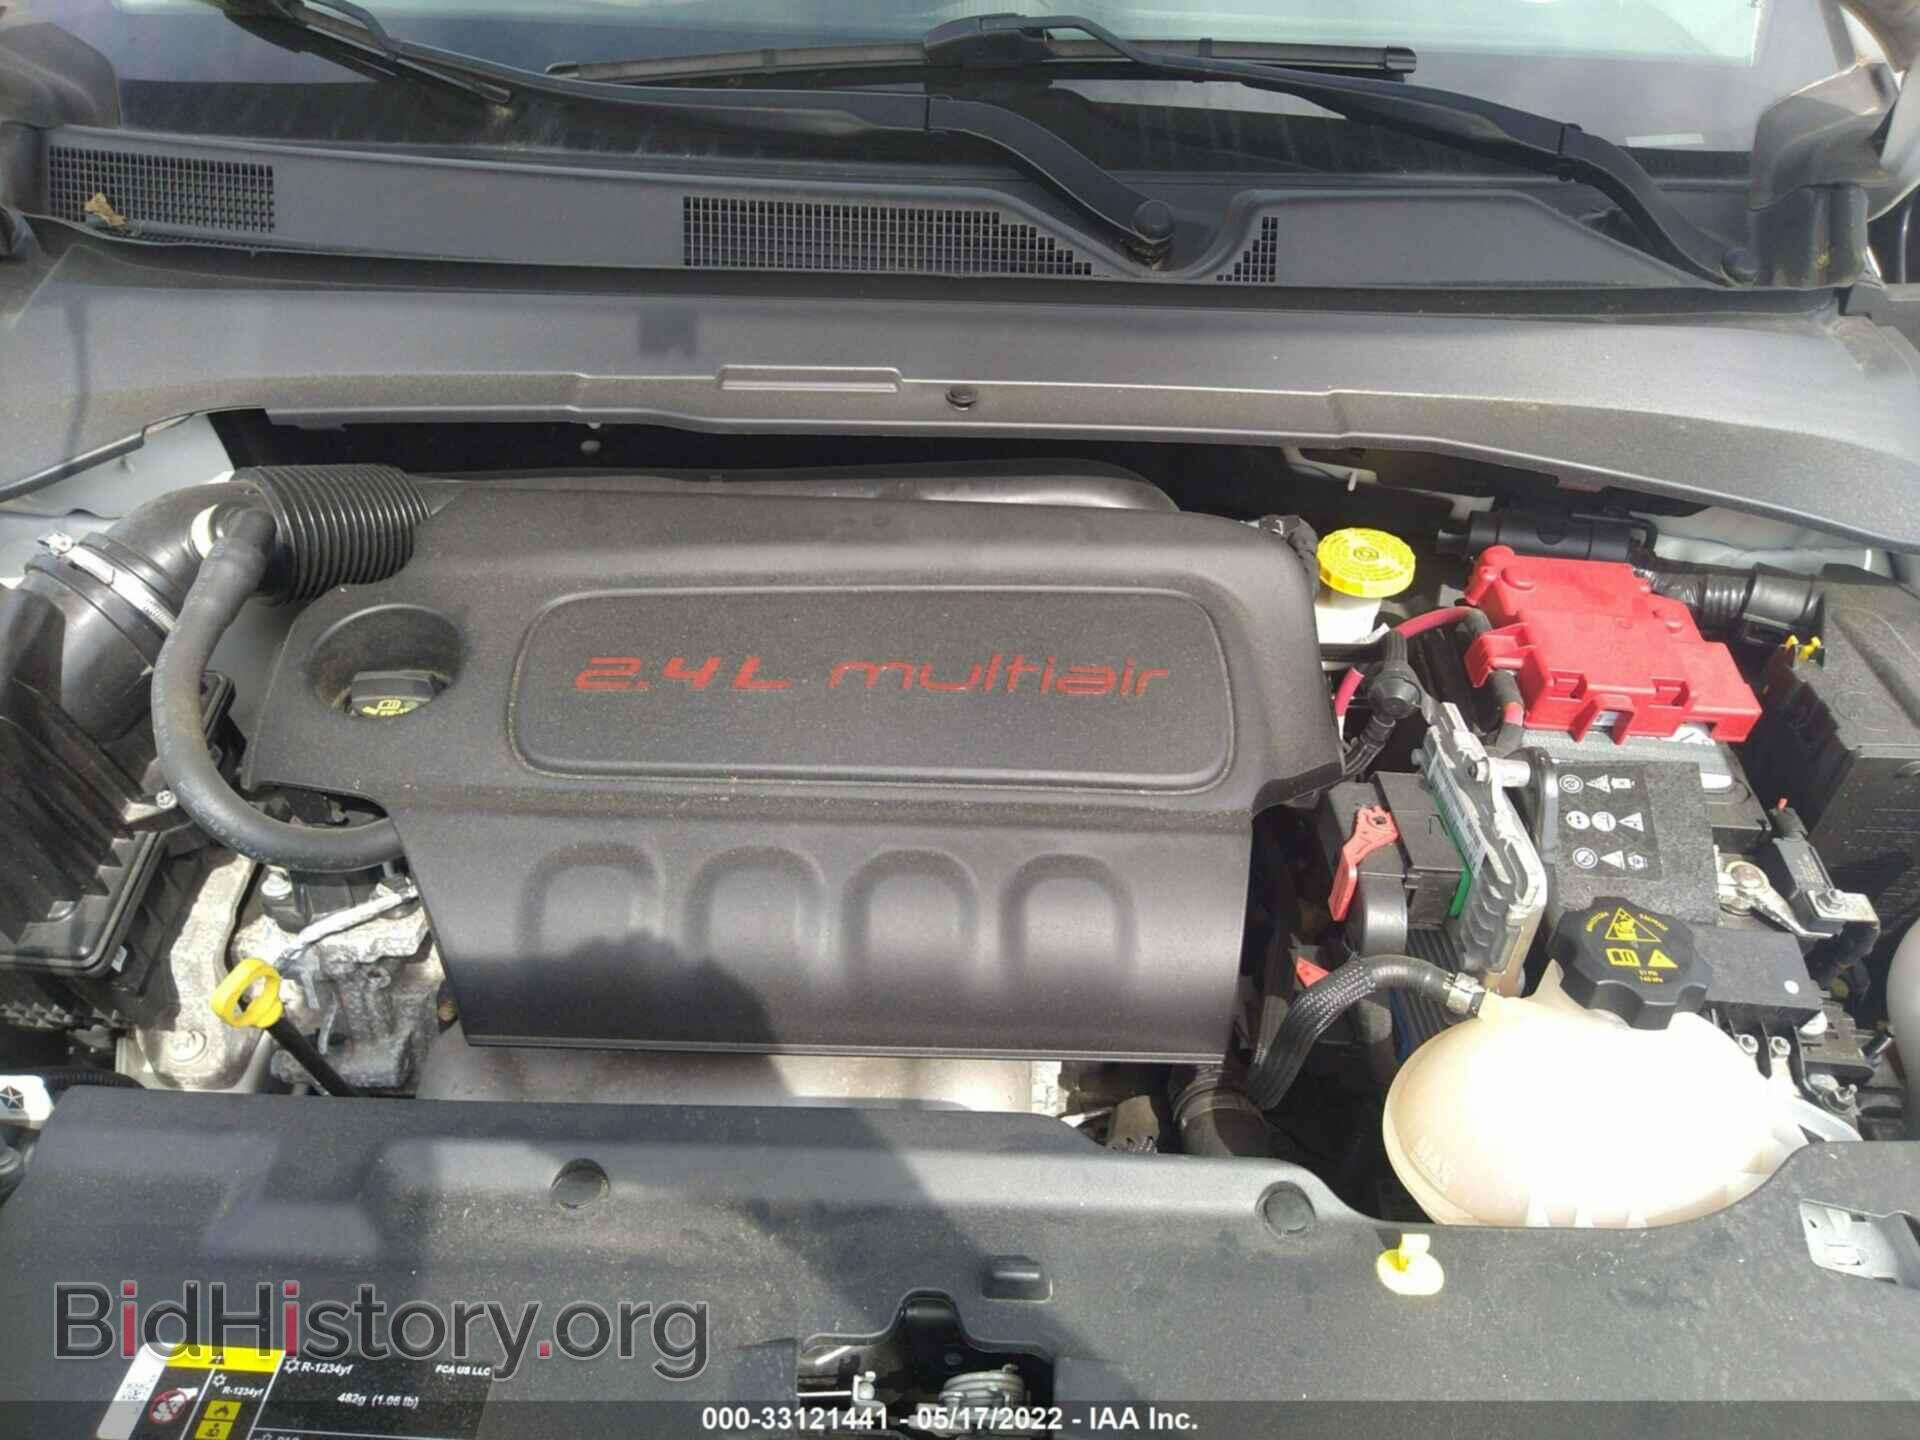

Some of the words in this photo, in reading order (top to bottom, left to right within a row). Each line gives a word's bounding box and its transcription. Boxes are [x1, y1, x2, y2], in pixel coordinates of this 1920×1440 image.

[575, 656, 793, 690] 2.4L
[827, 654, 1169, 696] multiair
[301, 1362, 353, 1376] R-1234yf
[435, 1364, 455, 1375] FCA
[472, 1366, 491, 1376] LLC
